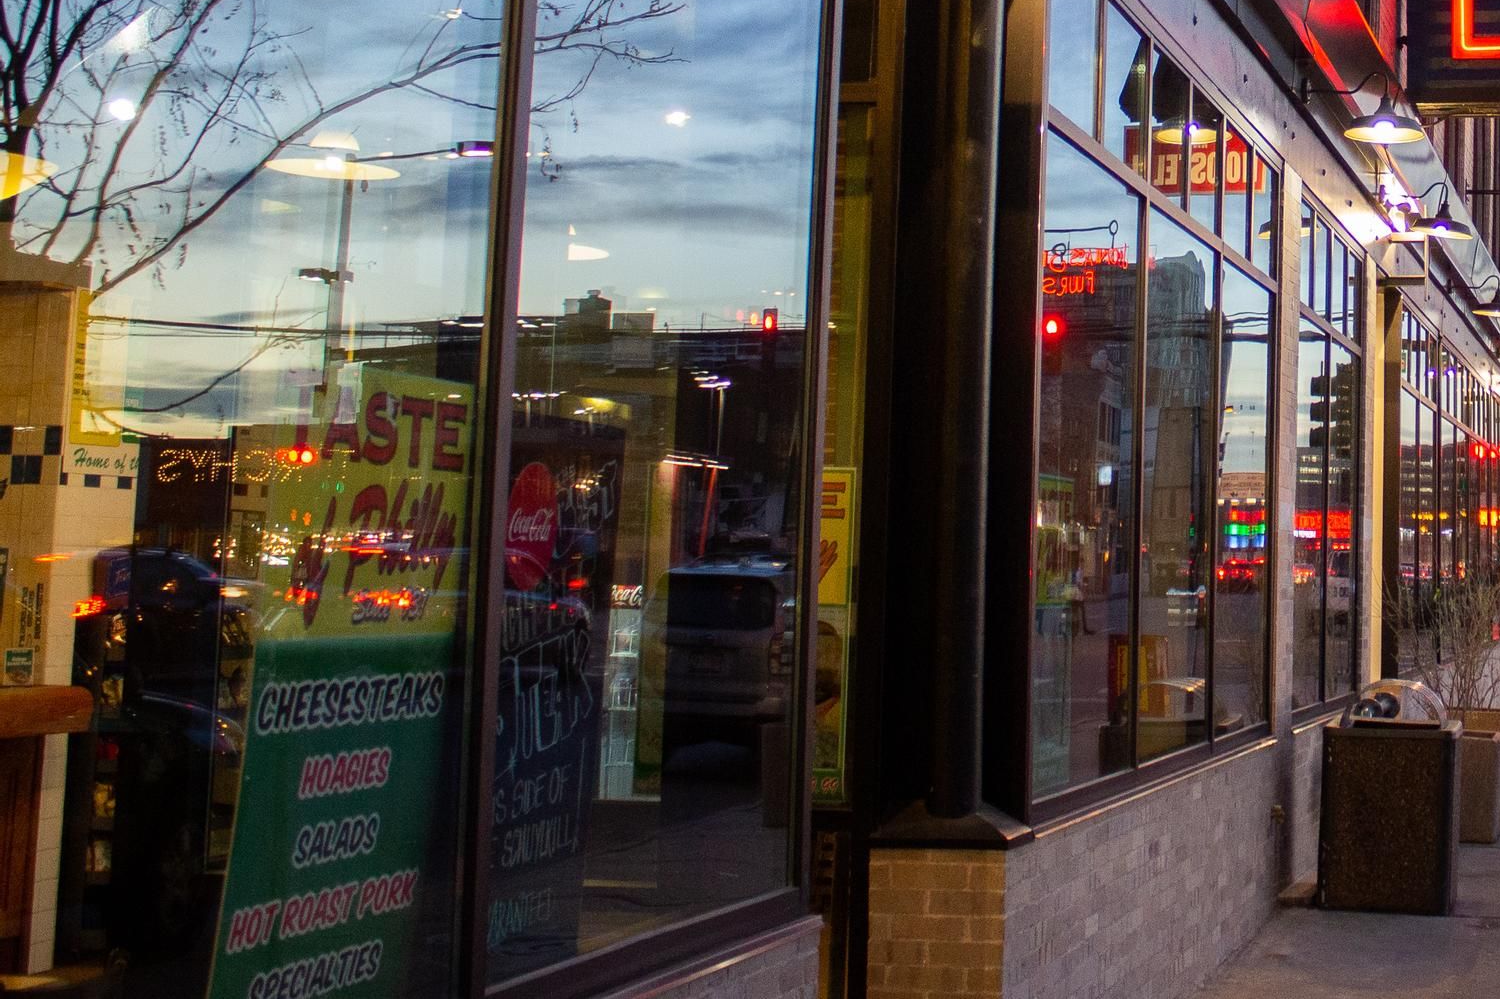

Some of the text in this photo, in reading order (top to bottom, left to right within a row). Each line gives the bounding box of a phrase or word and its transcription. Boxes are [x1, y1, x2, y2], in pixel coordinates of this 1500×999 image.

[73, 448, 110, 468] Home
[508, 508, 554, 542] Coca-Cola
[256, 672, 445, 735] CHEESESTEAKS
[299, 747, 391, 799] HOAGIES
[292, 813, 380, 868] SALADS
[226, 869, 419, 954] HOT ROAST PORK
[249, 940, 383, 998] SPECIALTIES
